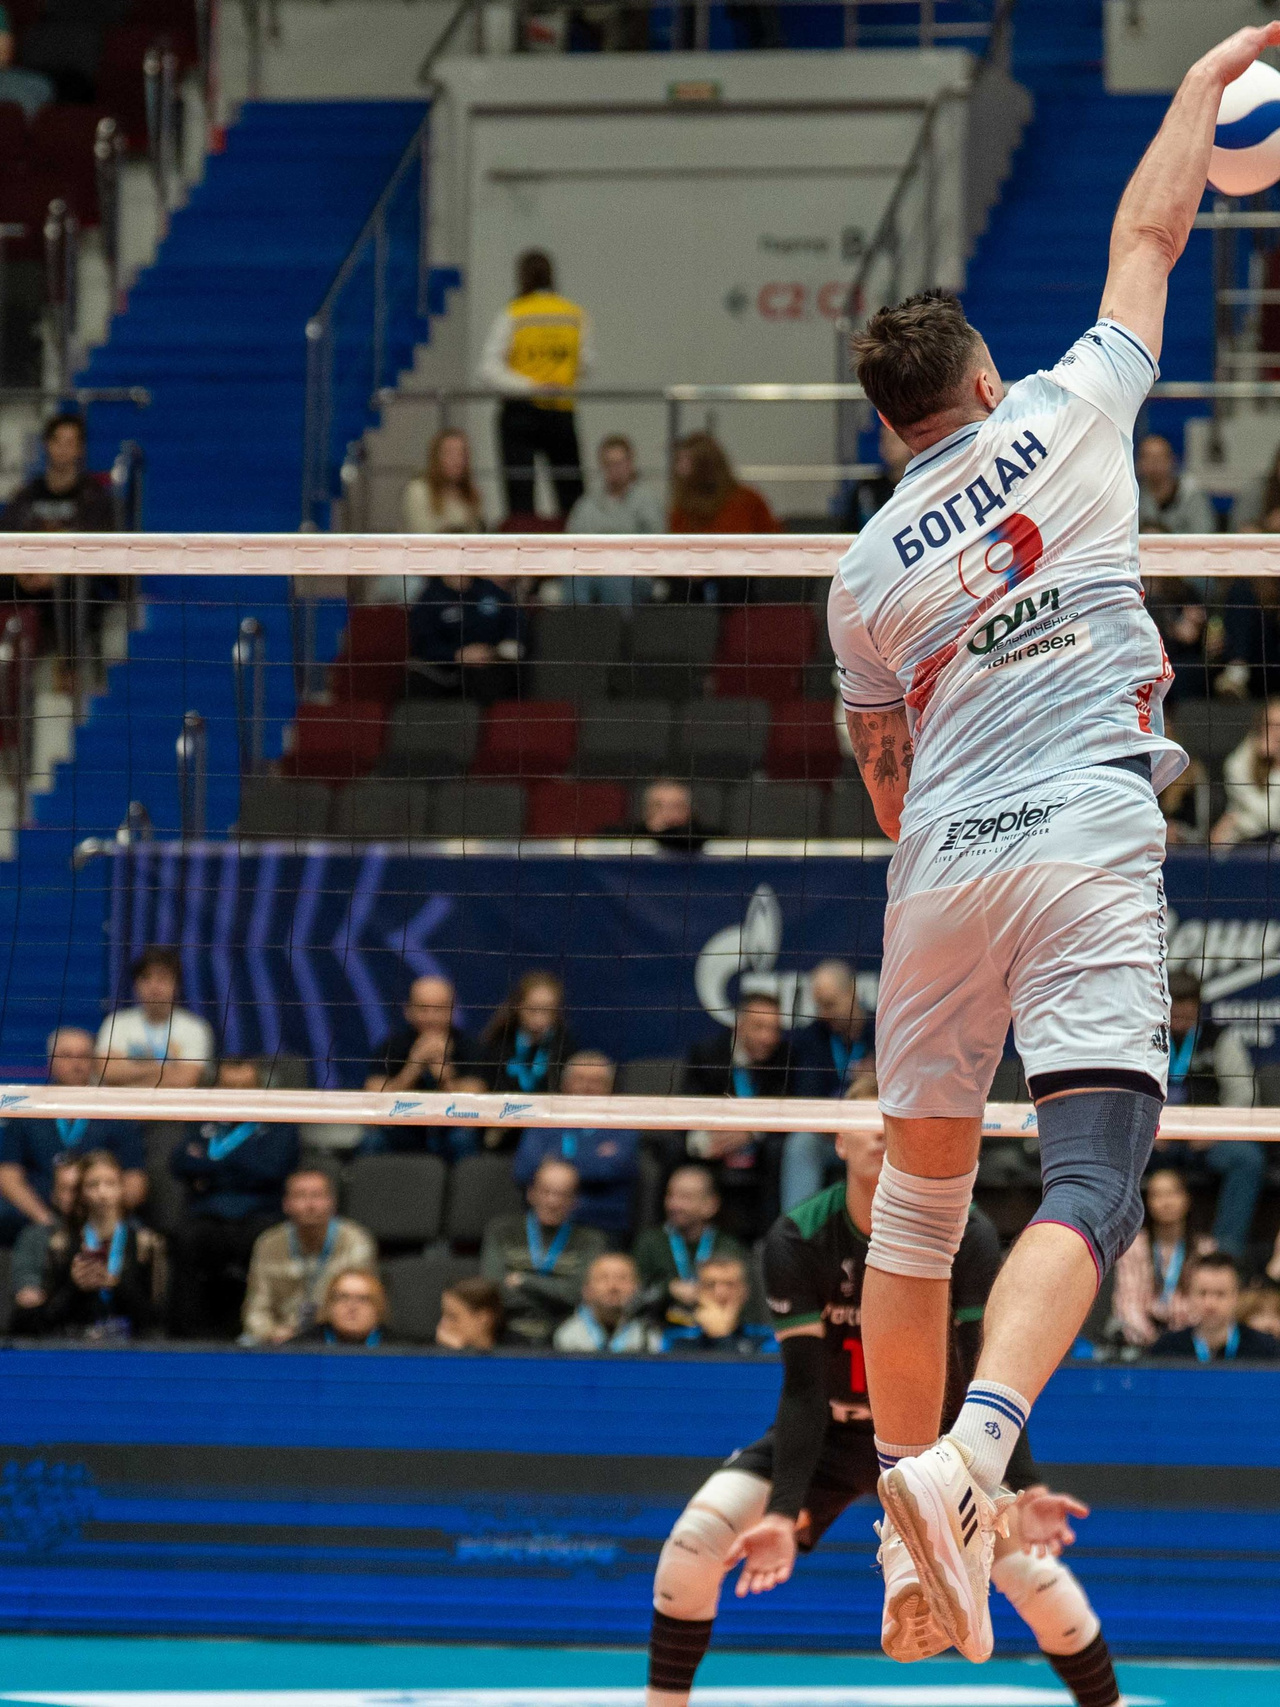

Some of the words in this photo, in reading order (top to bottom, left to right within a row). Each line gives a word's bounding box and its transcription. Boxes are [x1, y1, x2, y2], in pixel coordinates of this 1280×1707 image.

[892, 430, 1048, 569] БОГДАН
[988, 633, 1076, 669] ангазея
[962, 801, 1066, 843] zepter
[959, 849, 987, 859] ETTER
